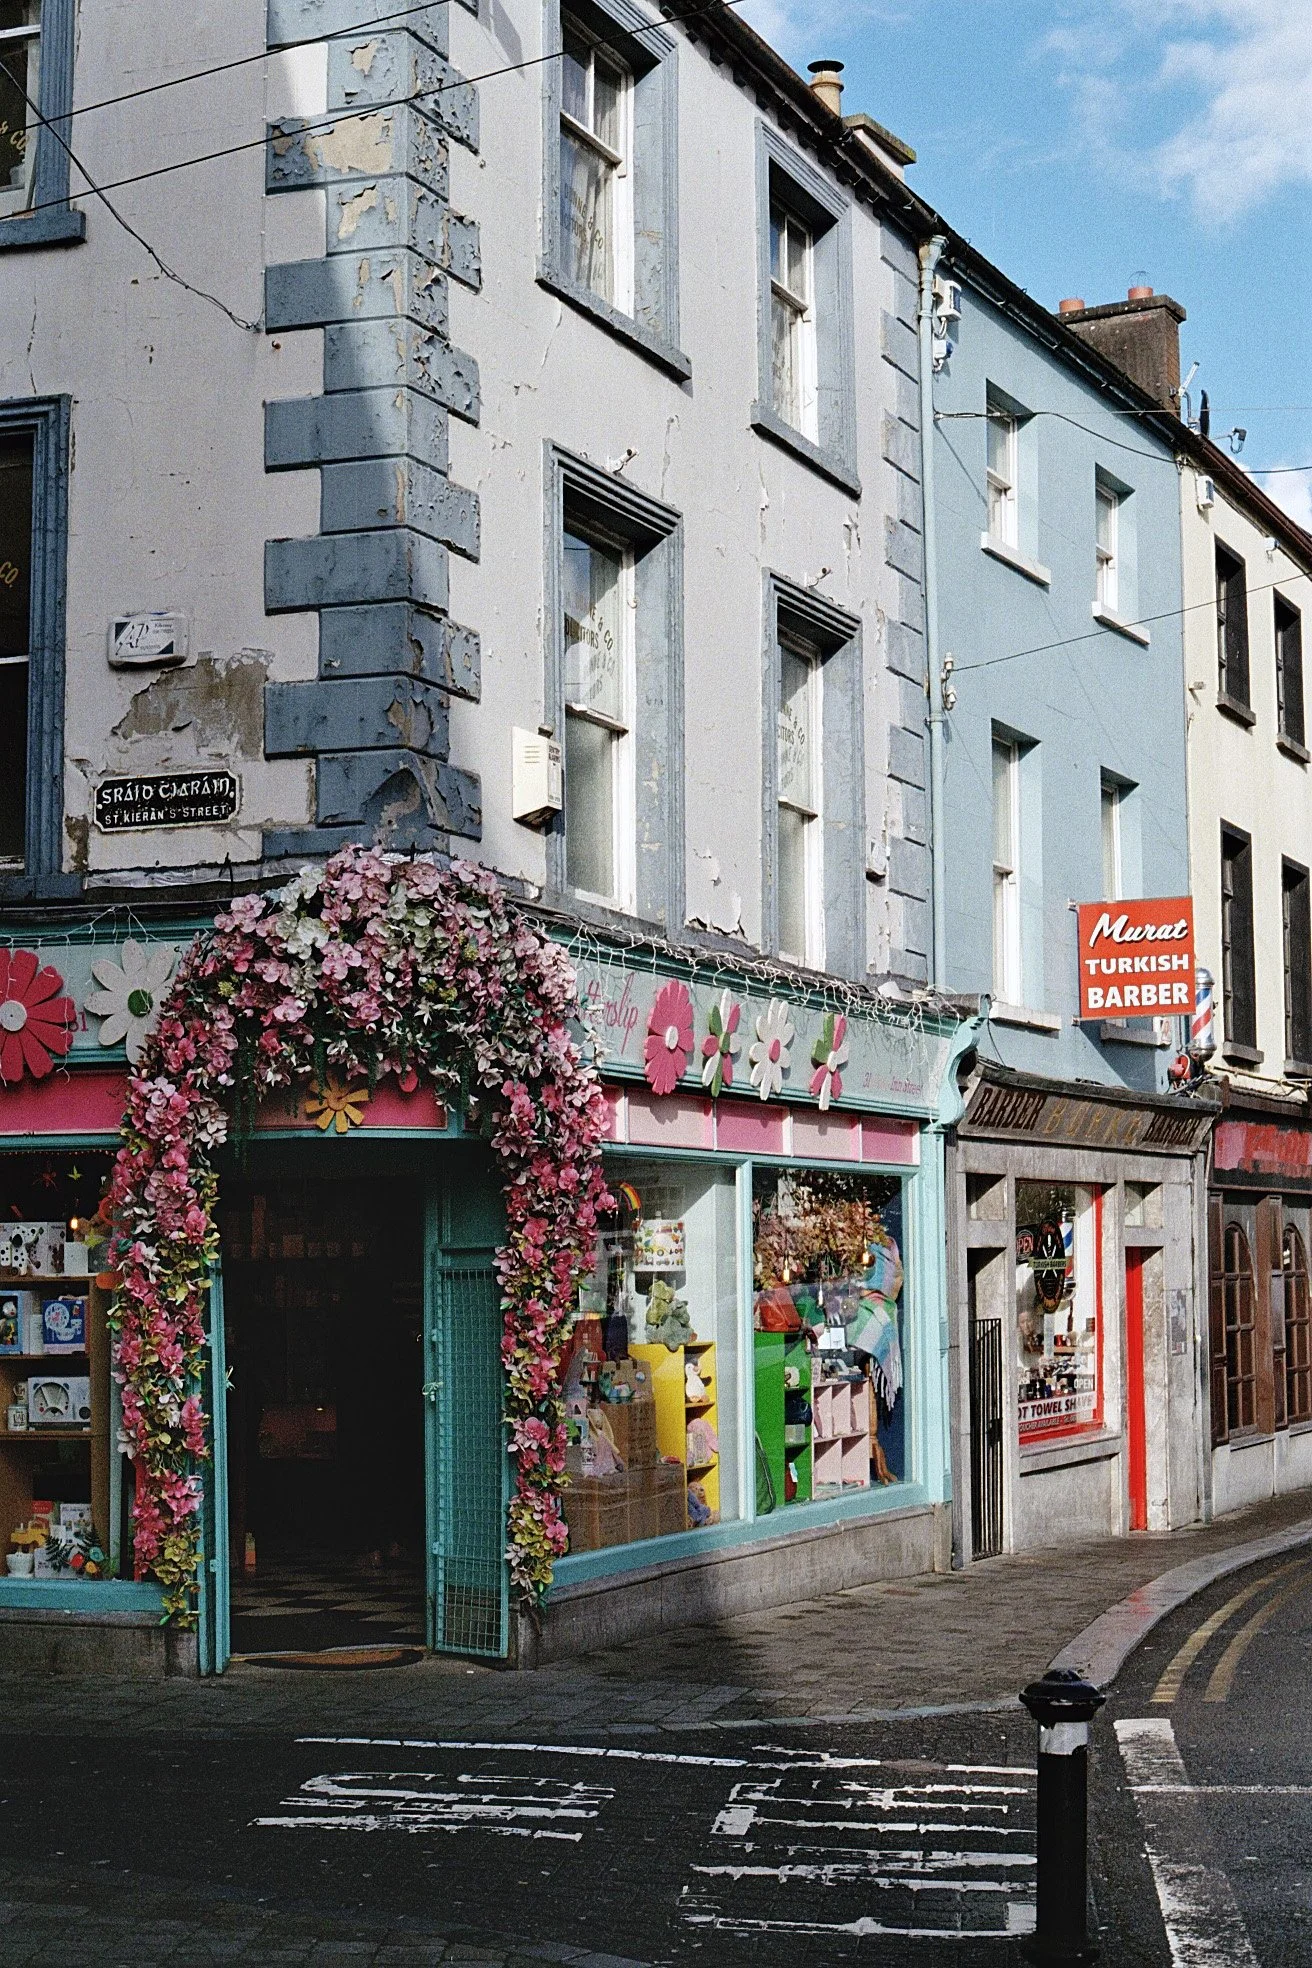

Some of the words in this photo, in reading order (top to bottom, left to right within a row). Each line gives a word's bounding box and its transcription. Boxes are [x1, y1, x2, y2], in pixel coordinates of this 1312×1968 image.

[102, 782, 154, 804] SRÁID
[182, 804, 229, 818] STREET
[1088, 912, 1188, 948] Murat
[1084, 954, 1189, 976] TURKISH
[1087, 982, 1190, 1009] BARBER
[968, 1087, 1047, 1130] BARBER
[1142, 1113, 1199, 1145] BARBER
[1016, 1236, 1033, 1253] PEN
[1074, 1379, 1093, 1389] OPEN
[1018, 1406, 1028, 1419] OT
[1031, 1401, 1062, 1417] TOWEL
[1065, 1394, 1092, 1411] SHAVE
[1019, 1421, 1037, 1432] OUCHER
